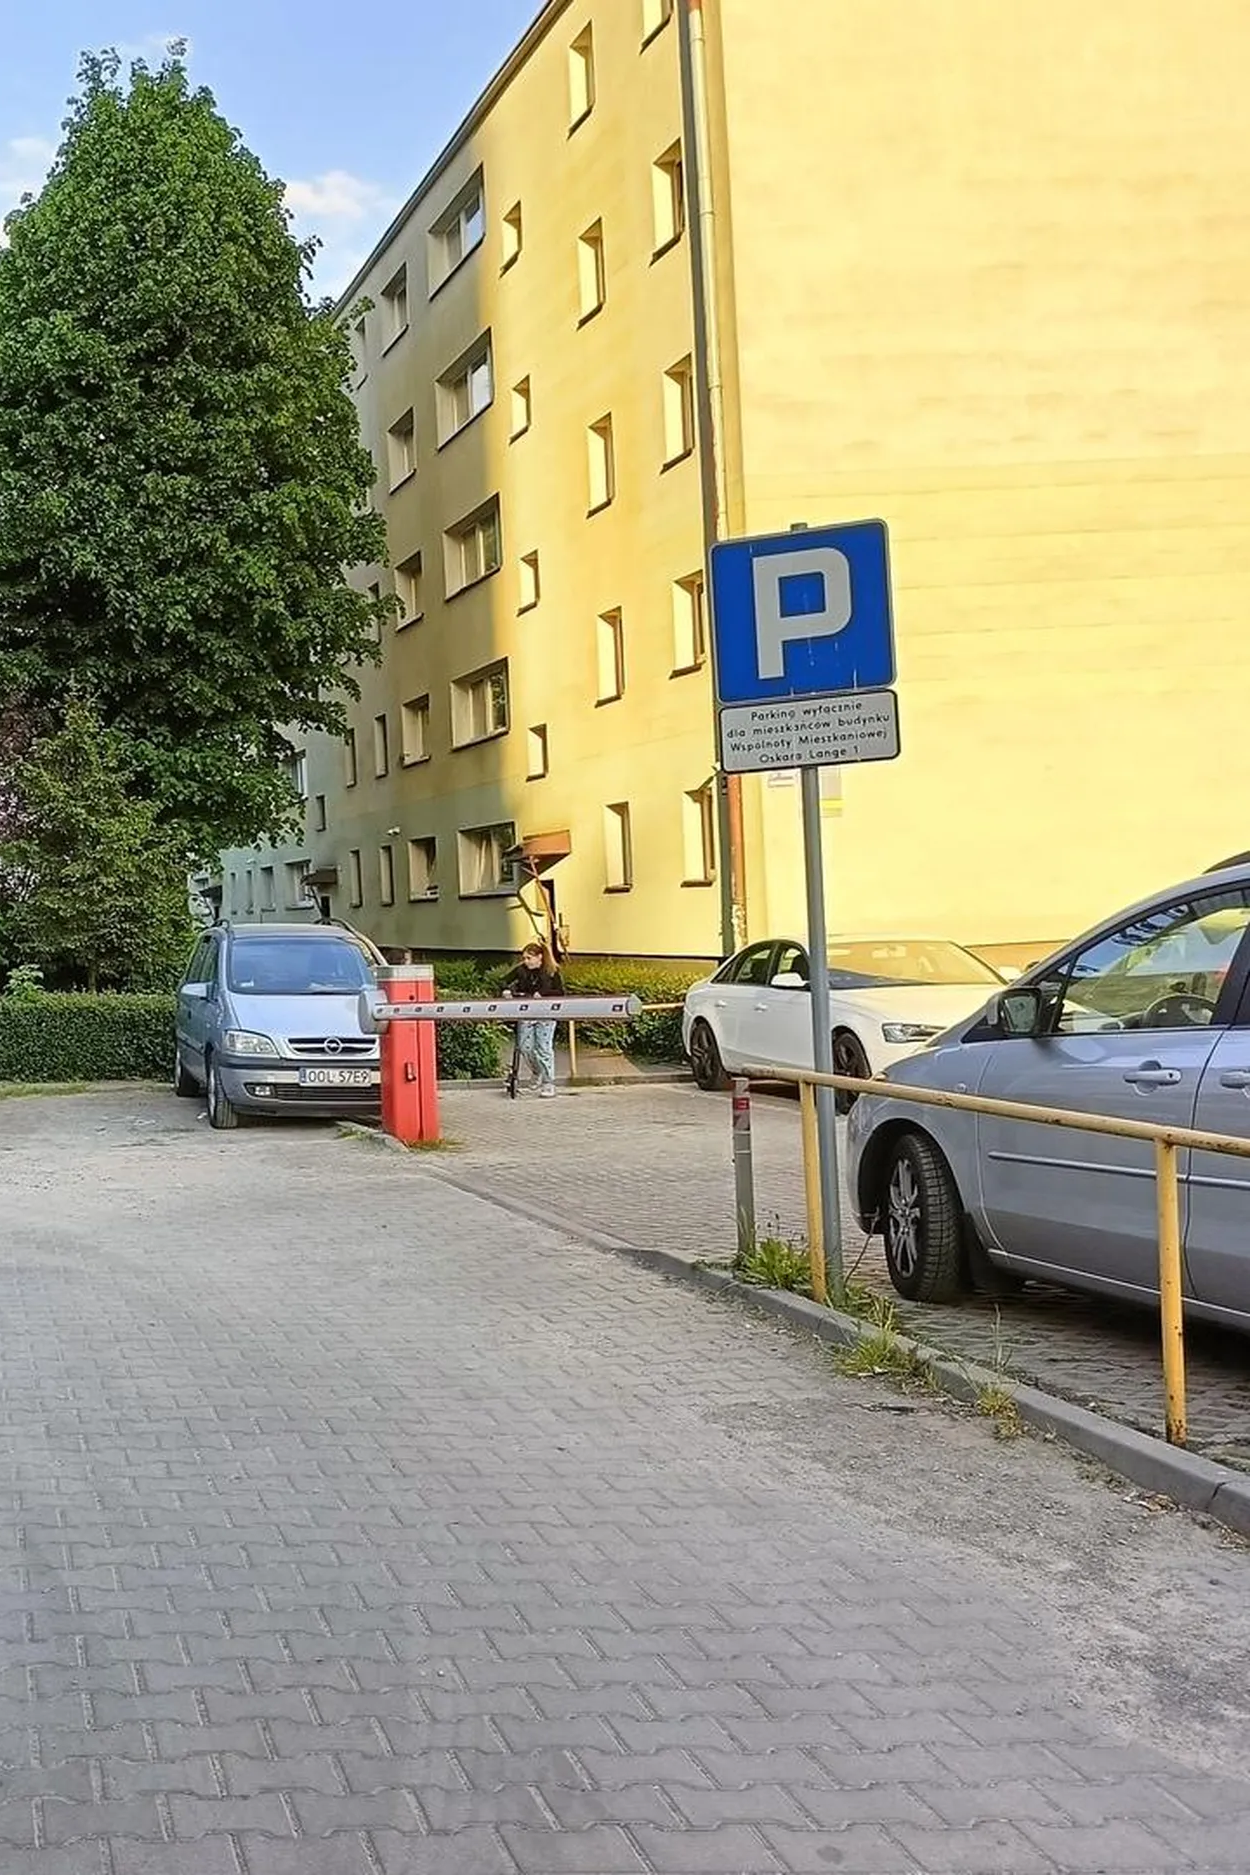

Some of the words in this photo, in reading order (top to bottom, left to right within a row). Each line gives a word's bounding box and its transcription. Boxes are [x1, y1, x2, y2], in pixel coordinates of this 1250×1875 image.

[752, 547, 852, 679] P
[751, 709, 796, 722] Parking
[727, 728, 746, 738] dla
[838, 713, 890, 728] budynku
[798, 729, 887, 744] Mieszkaniowej
[759, 752, 802, 763] Oskara
[809, 747, 847, 760] Lange
[853, 745, 859, 754] 1
